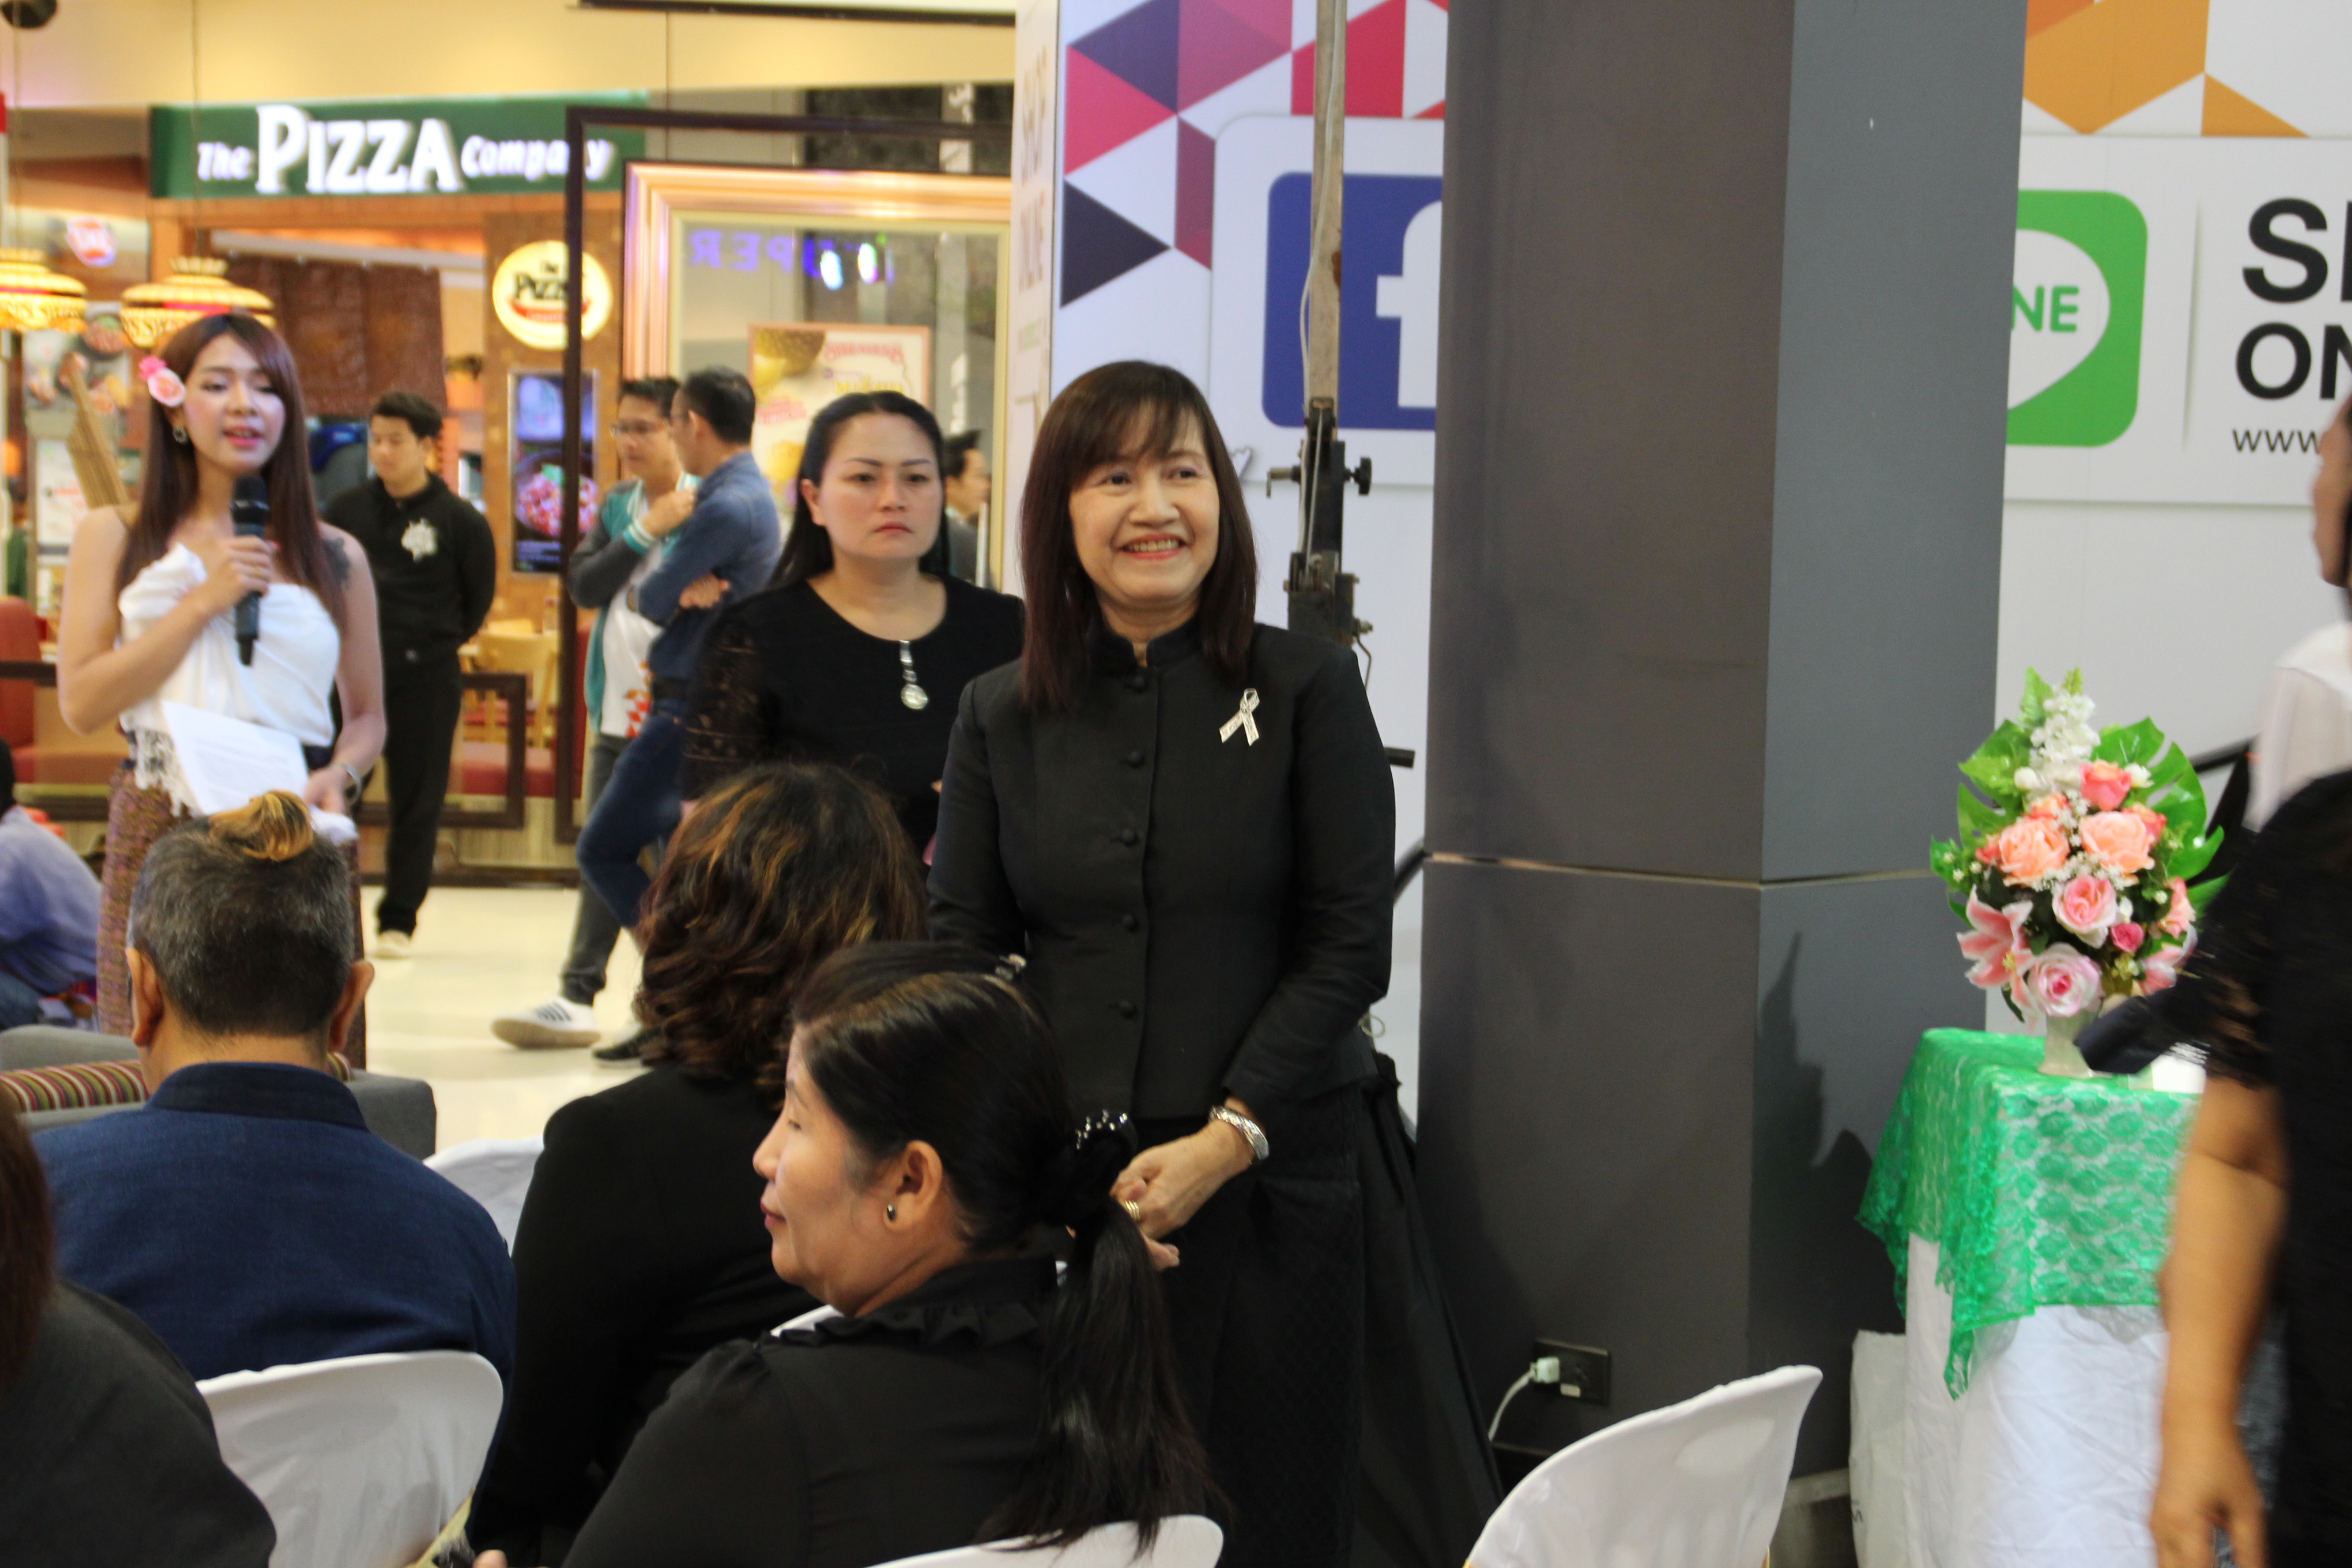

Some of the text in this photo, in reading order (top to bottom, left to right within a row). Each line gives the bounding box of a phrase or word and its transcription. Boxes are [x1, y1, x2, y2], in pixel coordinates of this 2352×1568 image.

[198, 104, 611, 194] The PIZZA Compay
[2242, 197, 2352, 304] S
[2011, 285, 2080, 332] NE
